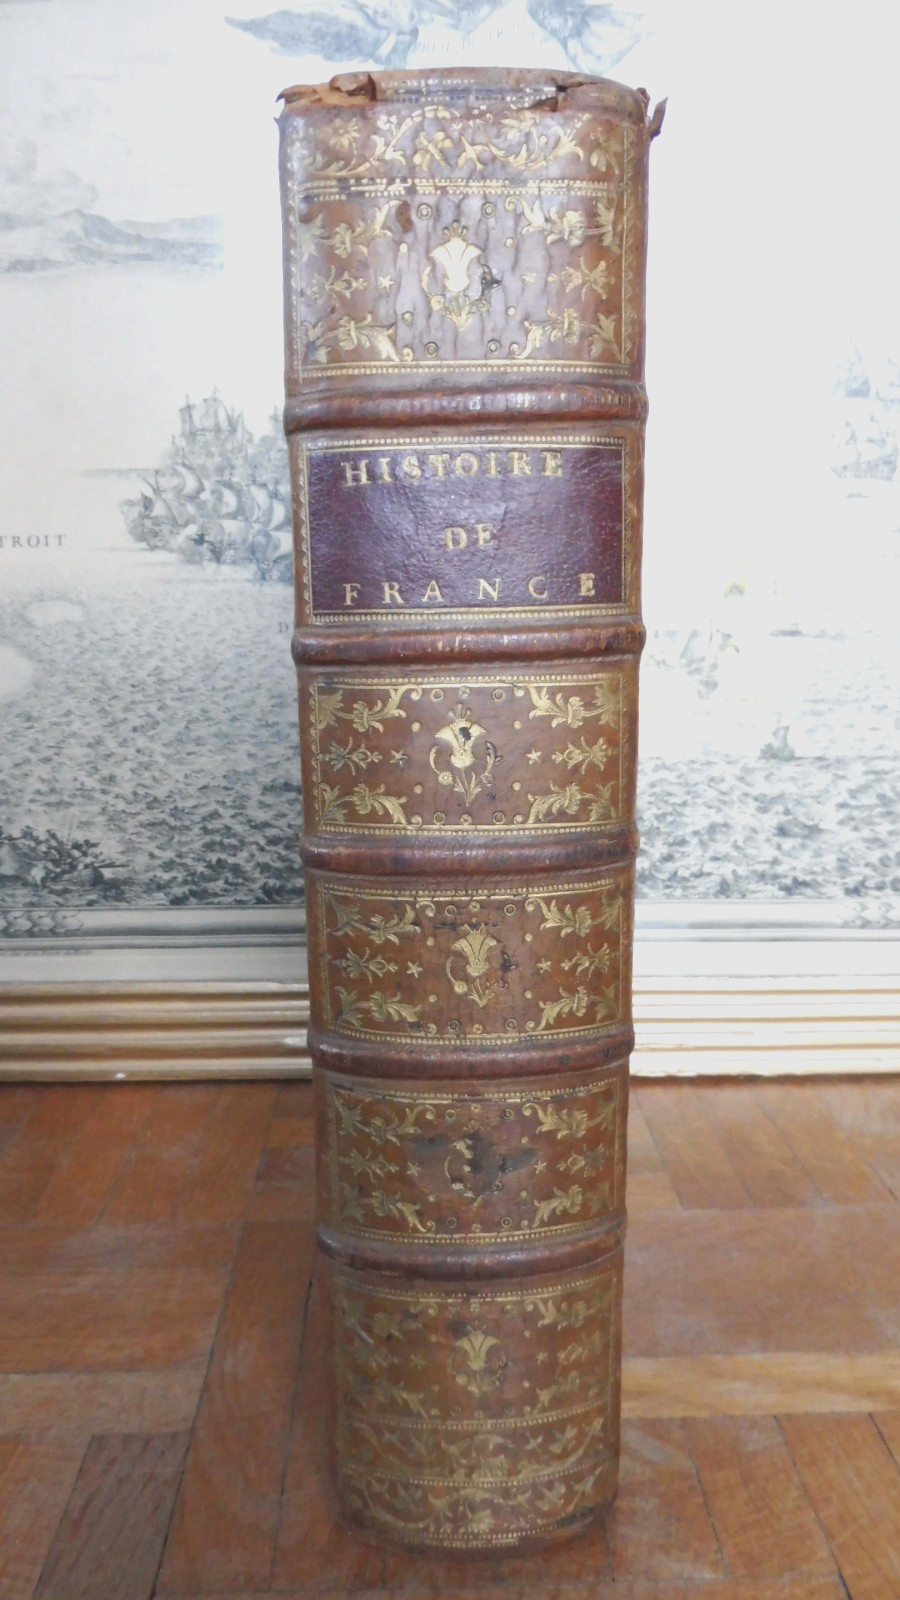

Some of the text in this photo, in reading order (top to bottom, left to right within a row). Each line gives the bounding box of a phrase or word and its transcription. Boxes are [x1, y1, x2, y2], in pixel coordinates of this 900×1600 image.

[341, 451, 563, 487] HISTOIRE
[444, 523, 496, 550] DE
[342, 572, 596, 605] FRANCE
